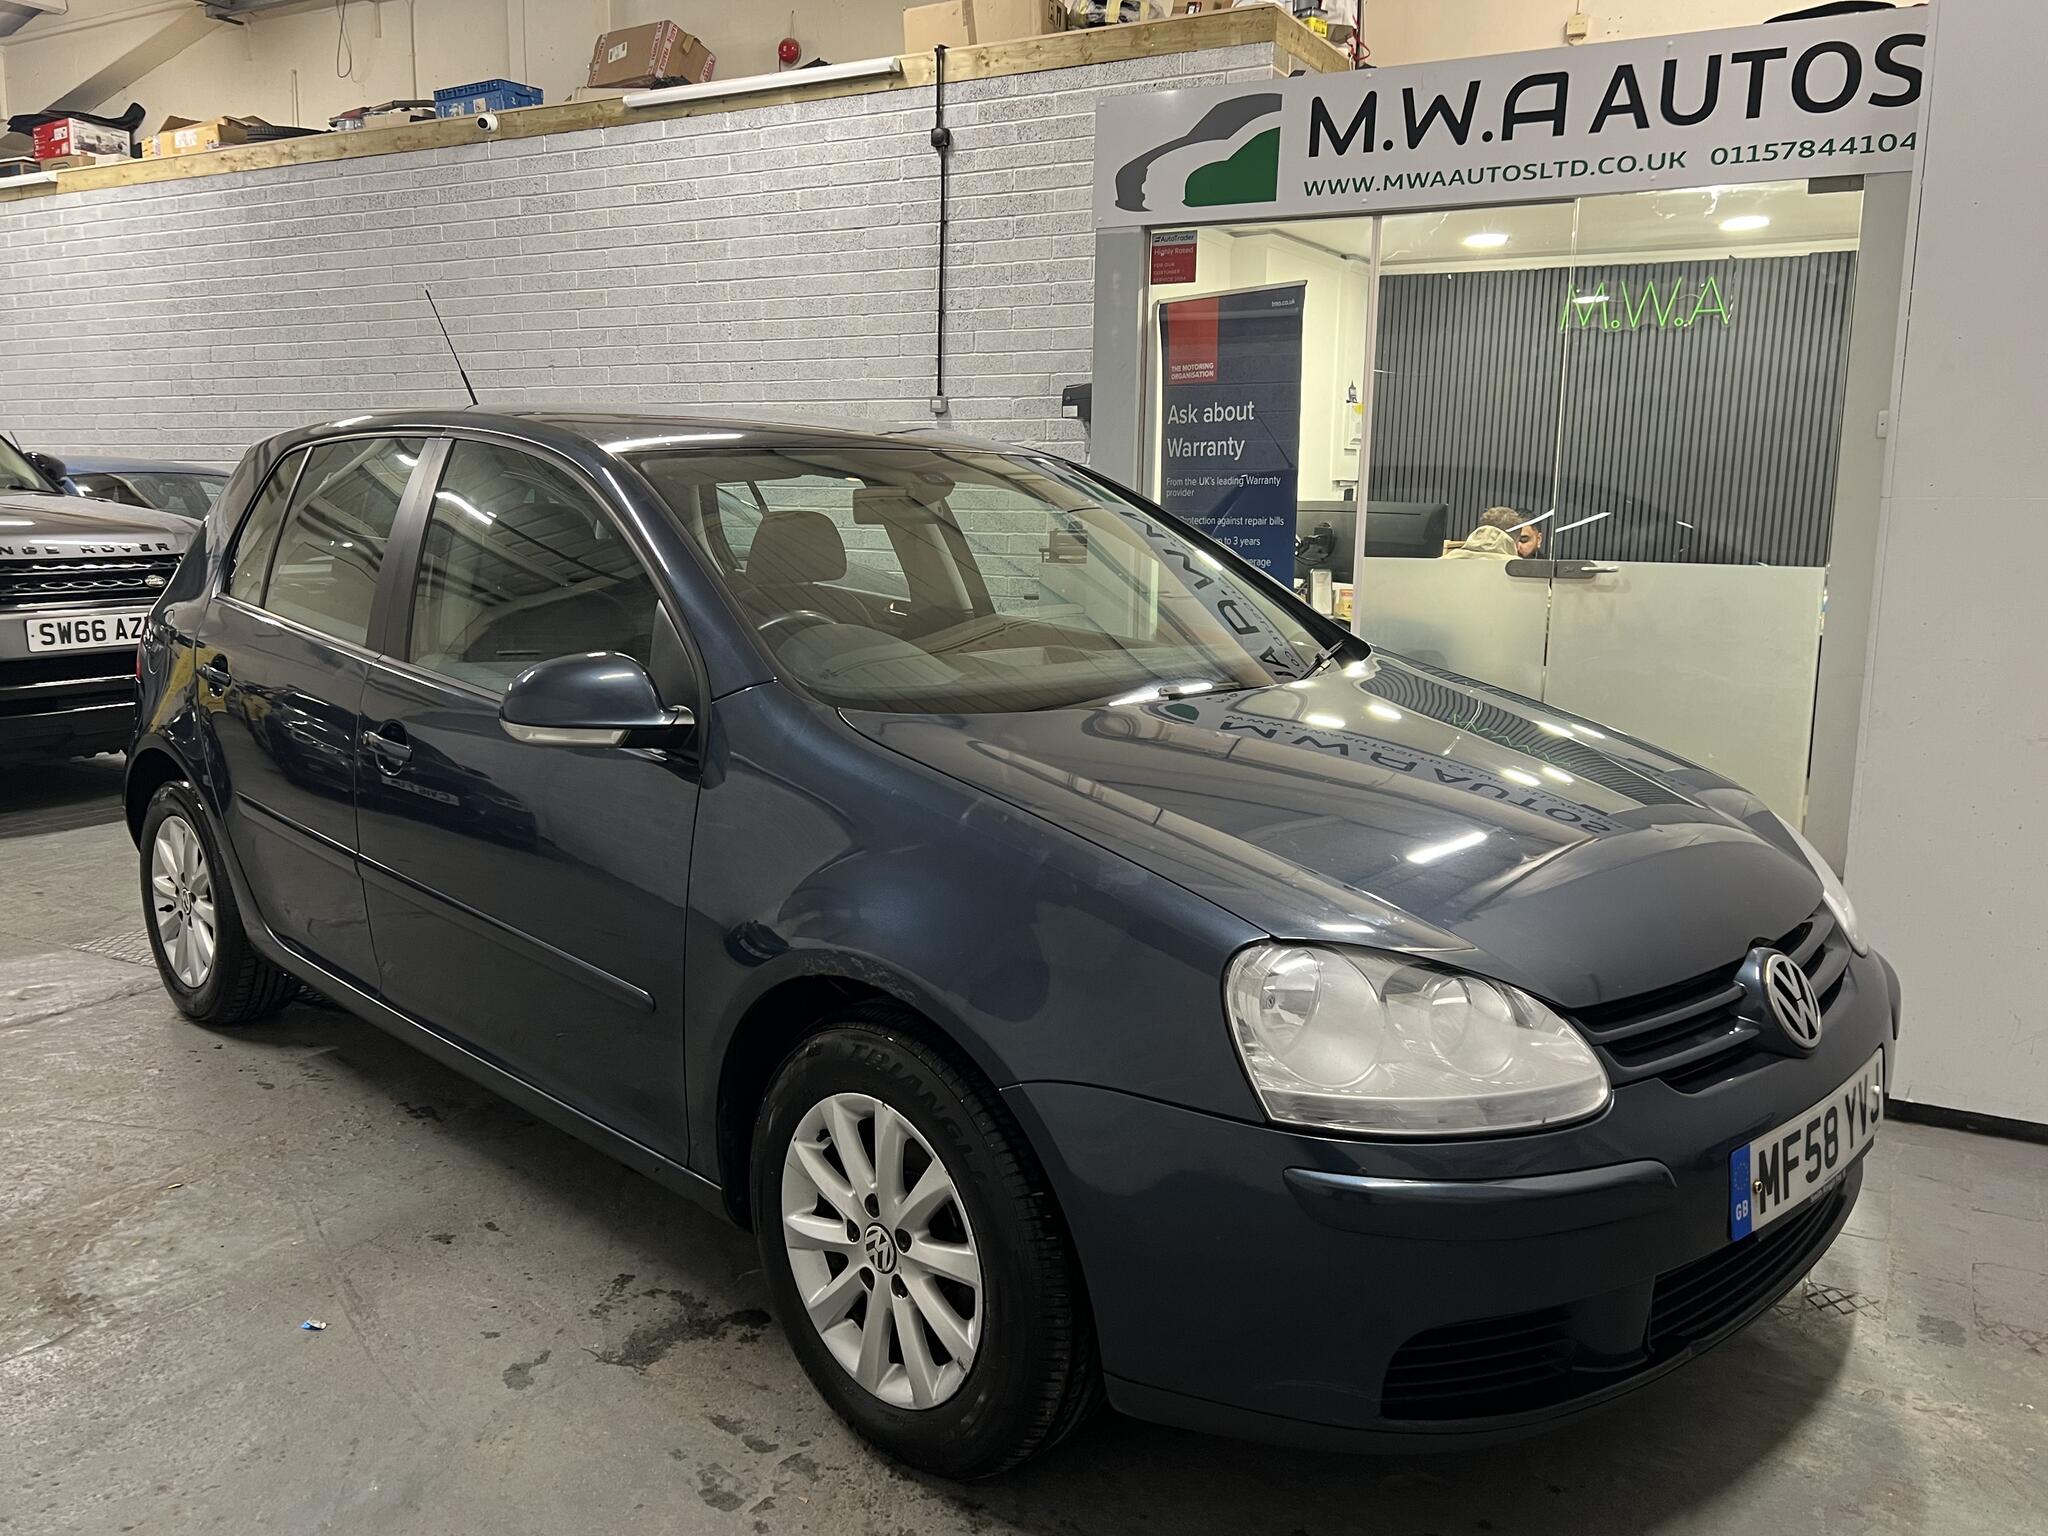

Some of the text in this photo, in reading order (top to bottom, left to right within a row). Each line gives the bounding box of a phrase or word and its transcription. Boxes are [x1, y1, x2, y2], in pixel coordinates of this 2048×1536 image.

[1308, 33, 1926, 157] M.W.A AUTOS
[1304, 131, 1916, 197] WWW.MWAAUTOSLTD.CO.UK 01157844104
[1153, 248, 1174, 257] Highly
[1559, 277, 1729, 331] M.W.A
[1171, 371, 1214, 380] ORGANISATION
[1182, 363, 1214, 371] MOTORING
[1167, 401, 1255, 425] Ask about
[1167, 436, 1246, 460] Warranty
[1166, 475, 1281, 487] From the UK's leading Warranty
[1166, 489, 1195, 498] provider
[1217, 516, 1243, 527] against
[1244, 516, 1267, 526] repair
[1269, 516, 1285, 526] bills
[80, 543, 171, 554] ROVER
[1224, 537, 1232, 545] to
[1233, 536, 1238, 545] 3
[1239, 537, 1261, 547] years
[39, 616, 148, 646] SW66 AZ
[1758, 1062, 1881, 1215] MF58 YVJ
[1735, 1199, 1749, 1221] GB
